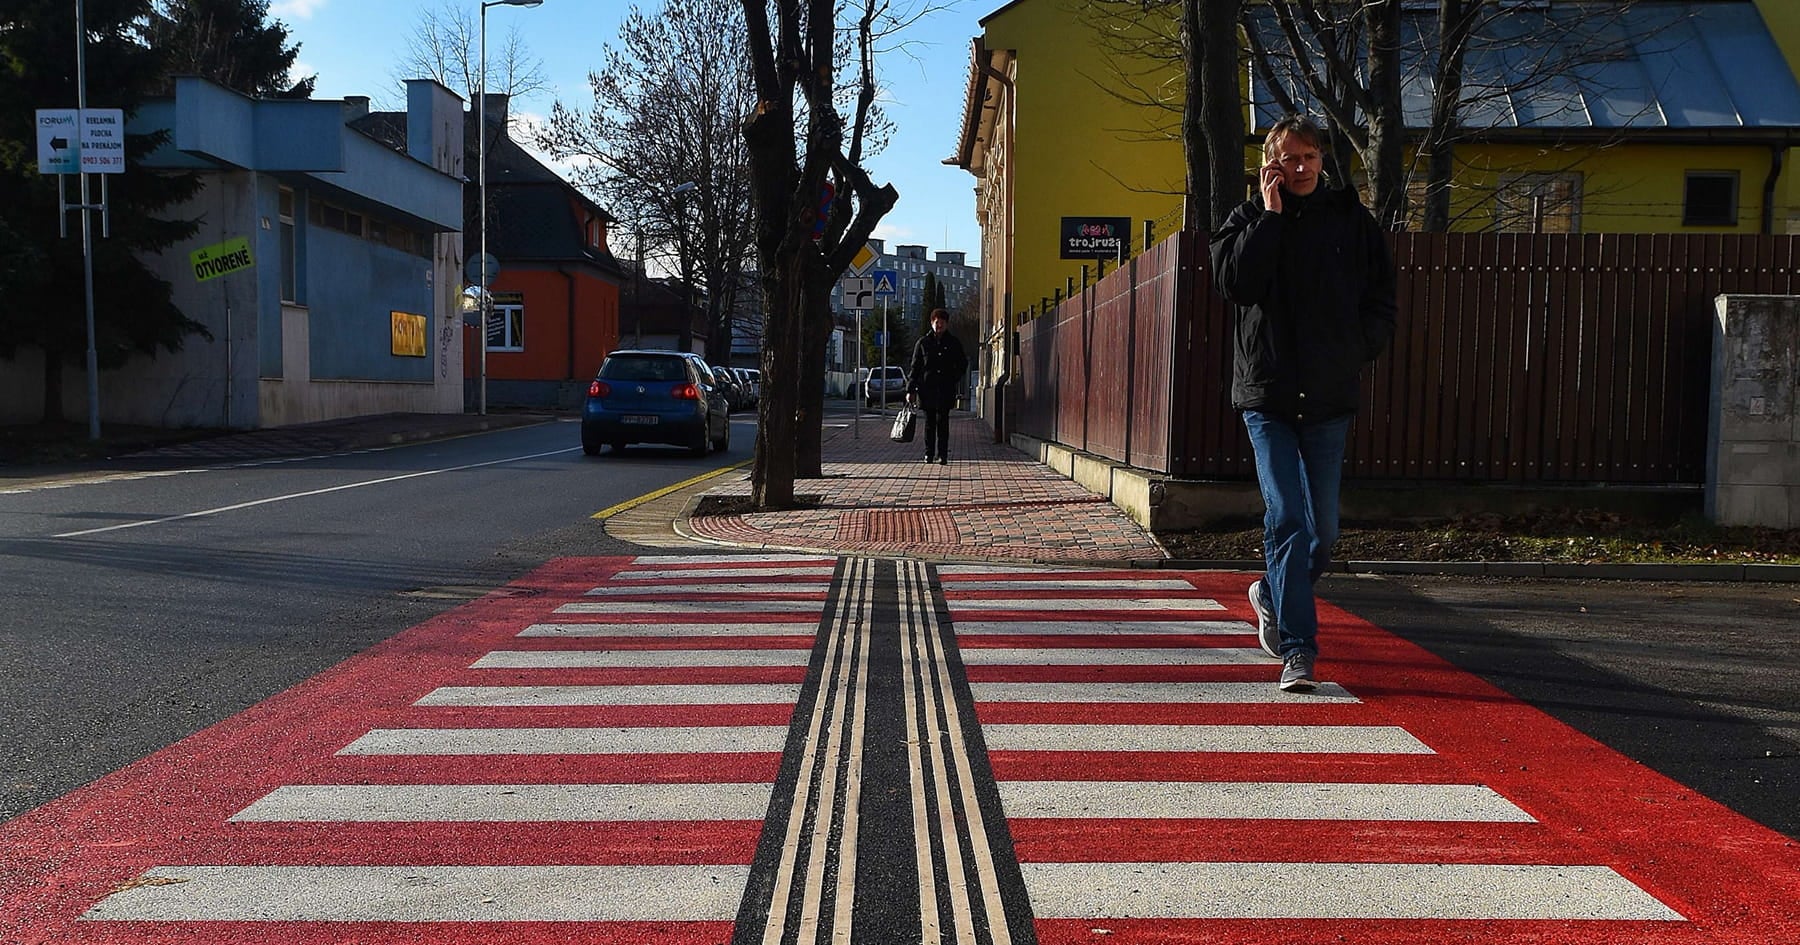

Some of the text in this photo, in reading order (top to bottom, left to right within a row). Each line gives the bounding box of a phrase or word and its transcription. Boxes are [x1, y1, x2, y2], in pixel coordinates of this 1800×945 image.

[40, 115, 75, 126] FORUM
[86, 116, 116, 124] REKLAMNÁ
[90, 129, 112, 137] PLOCHA
[91, 141, 122, 149] PRENÁJOM
[82, 156, 98, 164] 0903
[195, 244, 251, 279] OTVORENÉ
